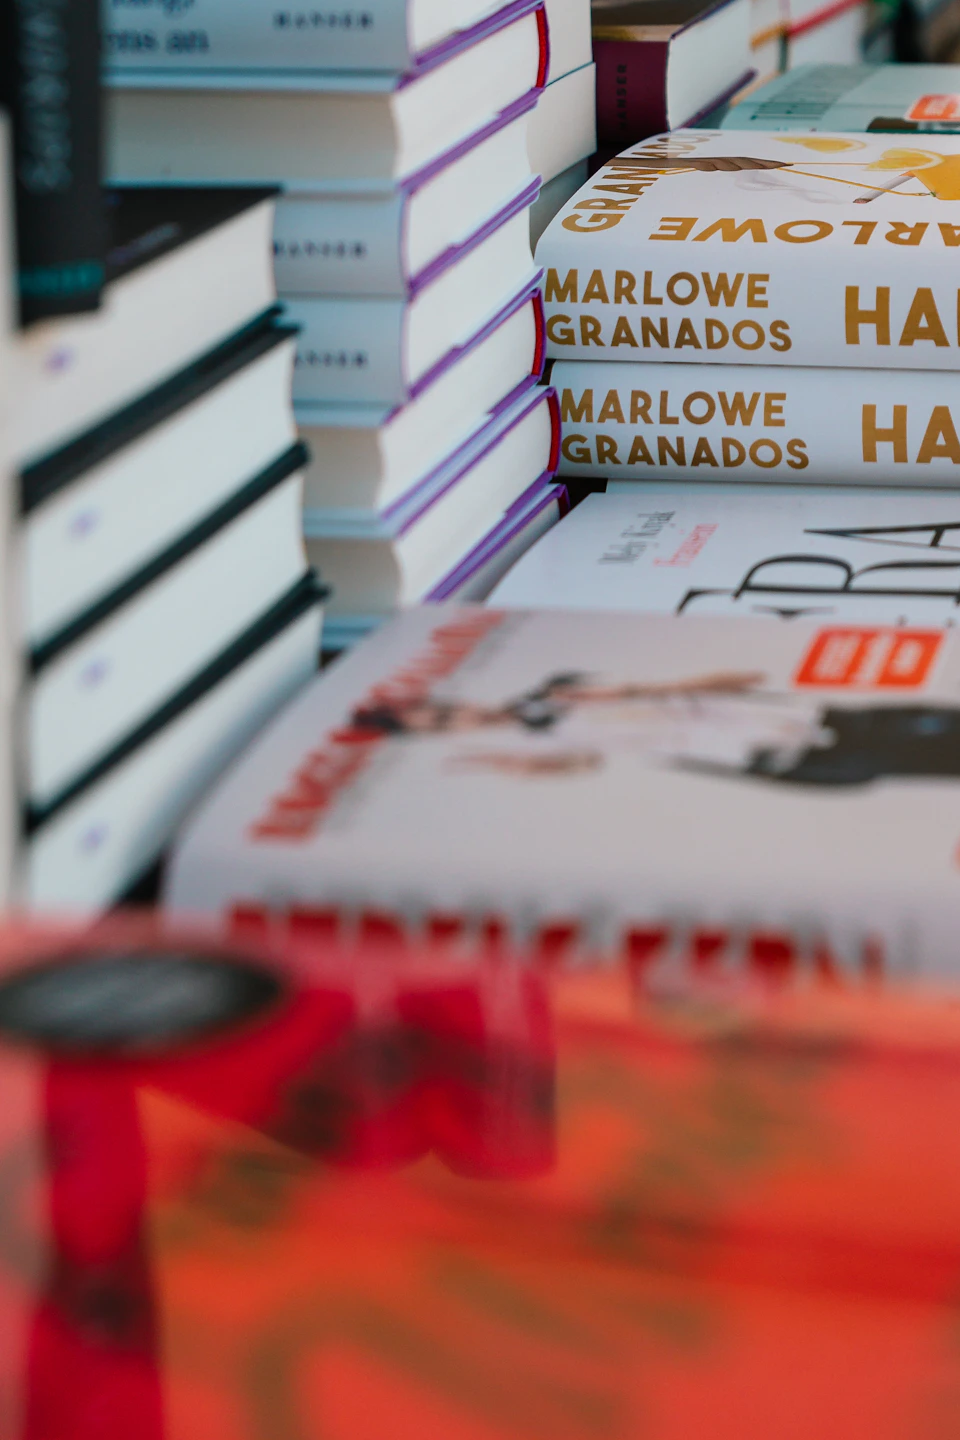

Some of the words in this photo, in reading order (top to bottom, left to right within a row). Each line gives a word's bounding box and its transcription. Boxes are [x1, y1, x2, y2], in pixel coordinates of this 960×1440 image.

[561, 133, 724, 233] GRANADO
[544, 268, 771, 309] MARLOWE
[546, 314, 793, 352] GRANADOS
[561, 388, 787, 428] MARLOWE
[560, 434, 810, 470] GRANADOS
